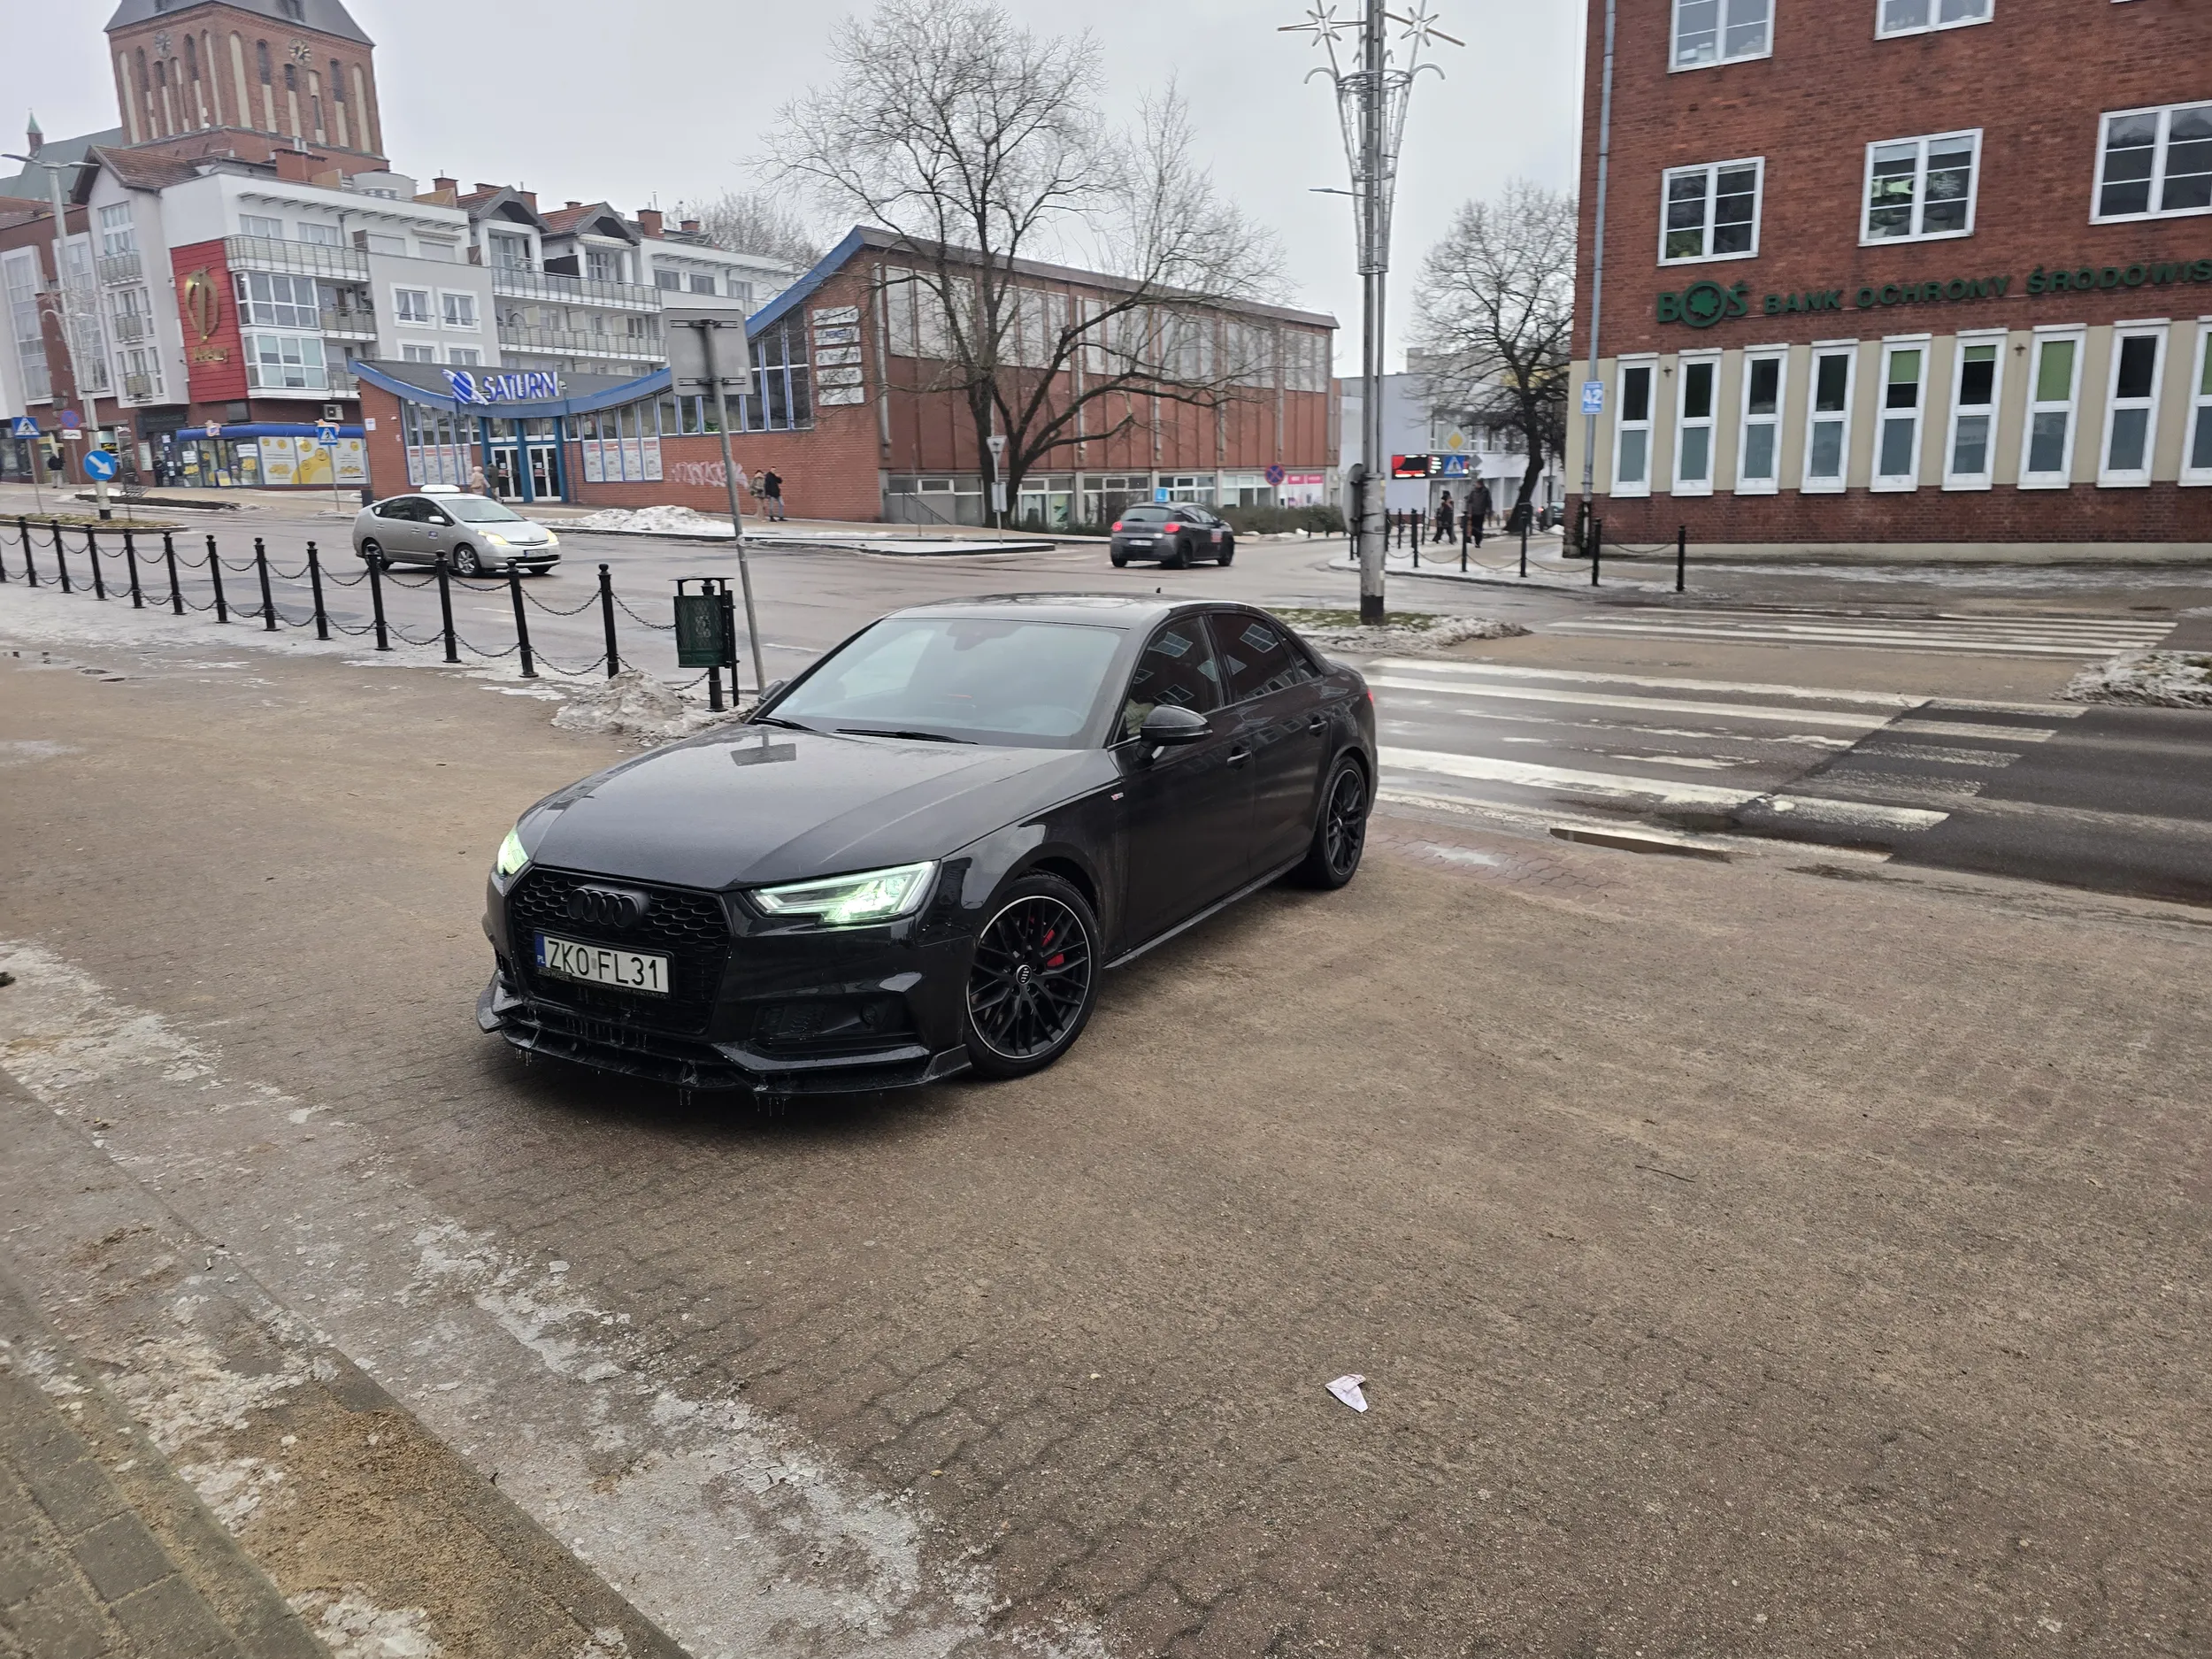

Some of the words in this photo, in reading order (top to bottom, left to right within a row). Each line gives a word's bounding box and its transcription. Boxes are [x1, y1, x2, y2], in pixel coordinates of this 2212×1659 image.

[1763, 289, 1843, 315] BANK
[1855, 275, 2010, 308] OCHRONY
[482, 371, 560, 402] SATURN
[537, 955, 546, 964] PL
[598, 950, 657, 988] FL31
